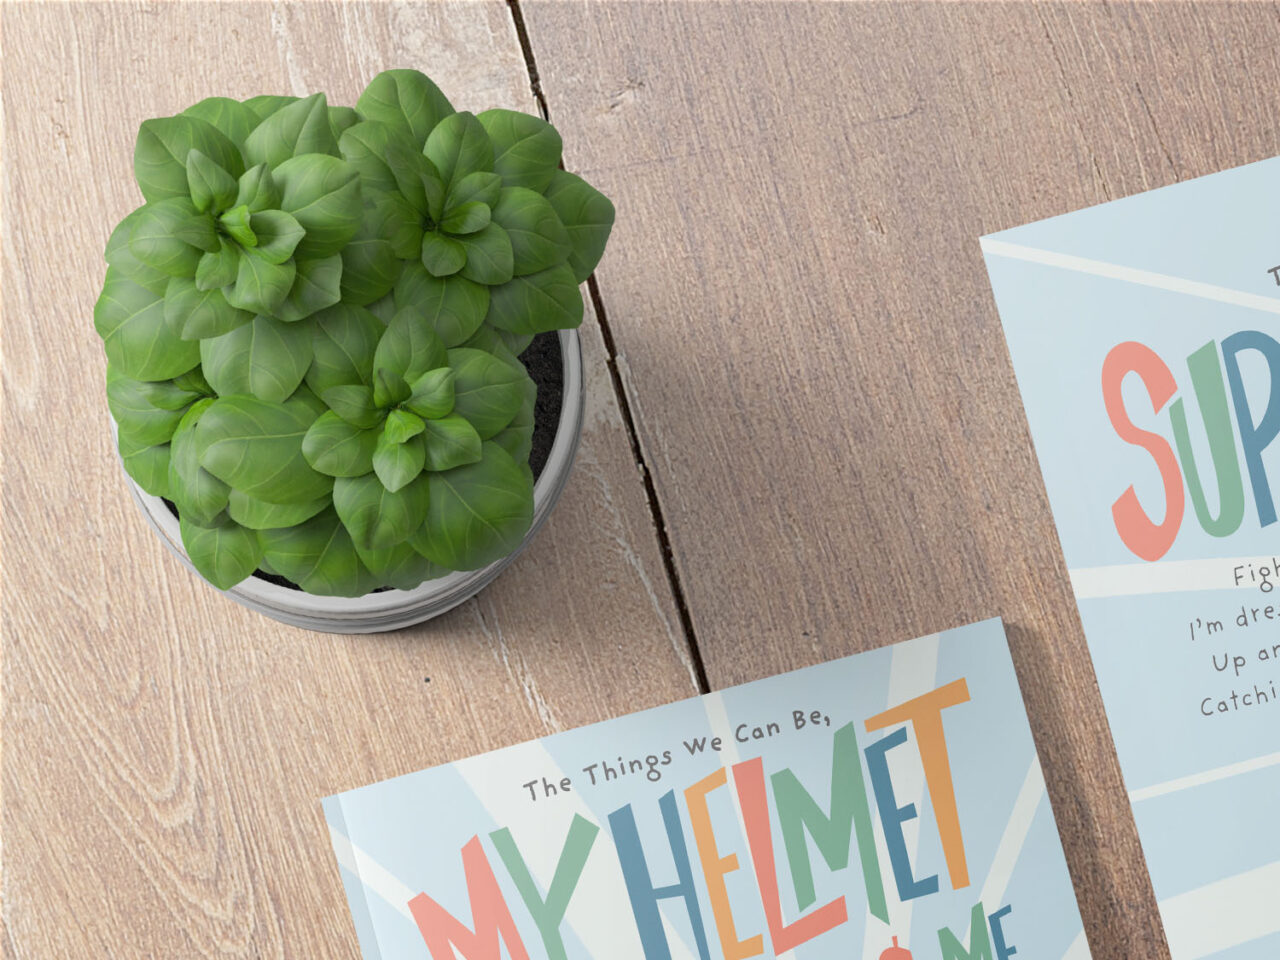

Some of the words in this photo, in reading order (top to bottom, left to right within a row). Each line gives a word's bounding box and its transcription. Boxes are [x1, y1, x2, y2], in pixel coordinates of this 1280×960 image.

[1212, 652, 1246, 677] Up
[522, 776, 572, 802] The
[582, 750, 672, 786] Things
[682, 736, 722, 756] We
[734, 722, 781, 743] Can
[792, 710, 831, 731] Be,
